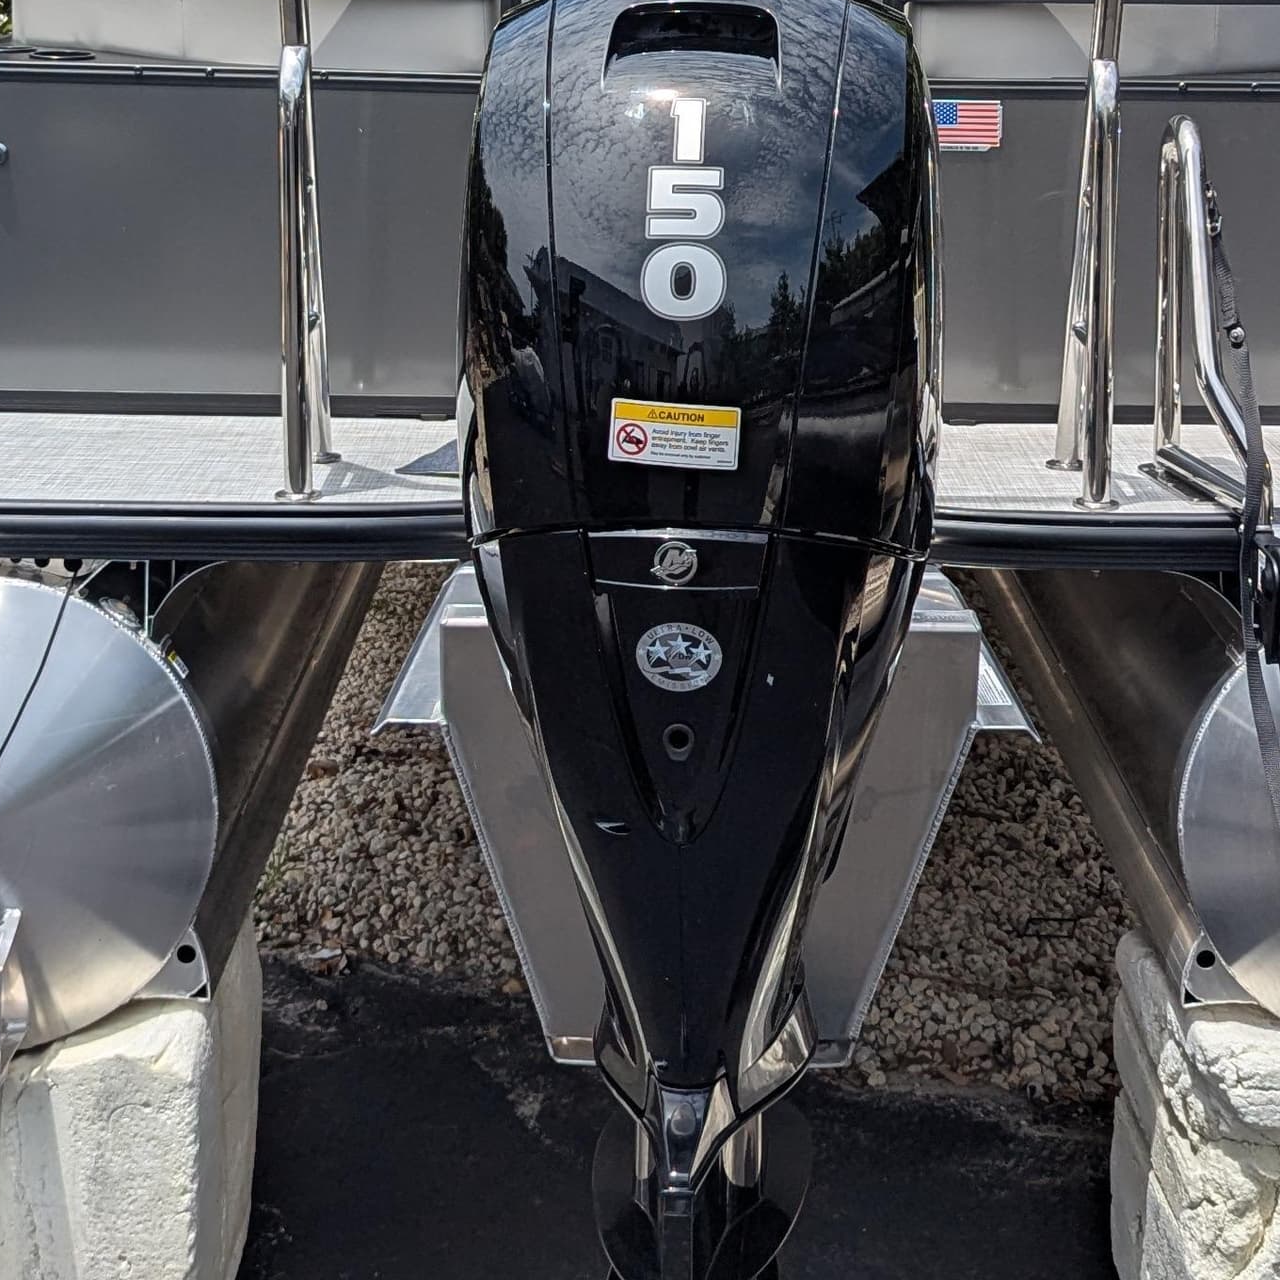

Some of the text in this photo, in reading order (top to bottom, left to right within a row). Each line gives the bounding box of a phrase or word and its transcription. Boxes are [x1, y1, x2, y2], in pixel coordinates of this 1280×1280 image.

[658, 411, 705, 423] CAUTION
[688, 430, 703, 438] from
[708, 438, 729, 447] fingers
